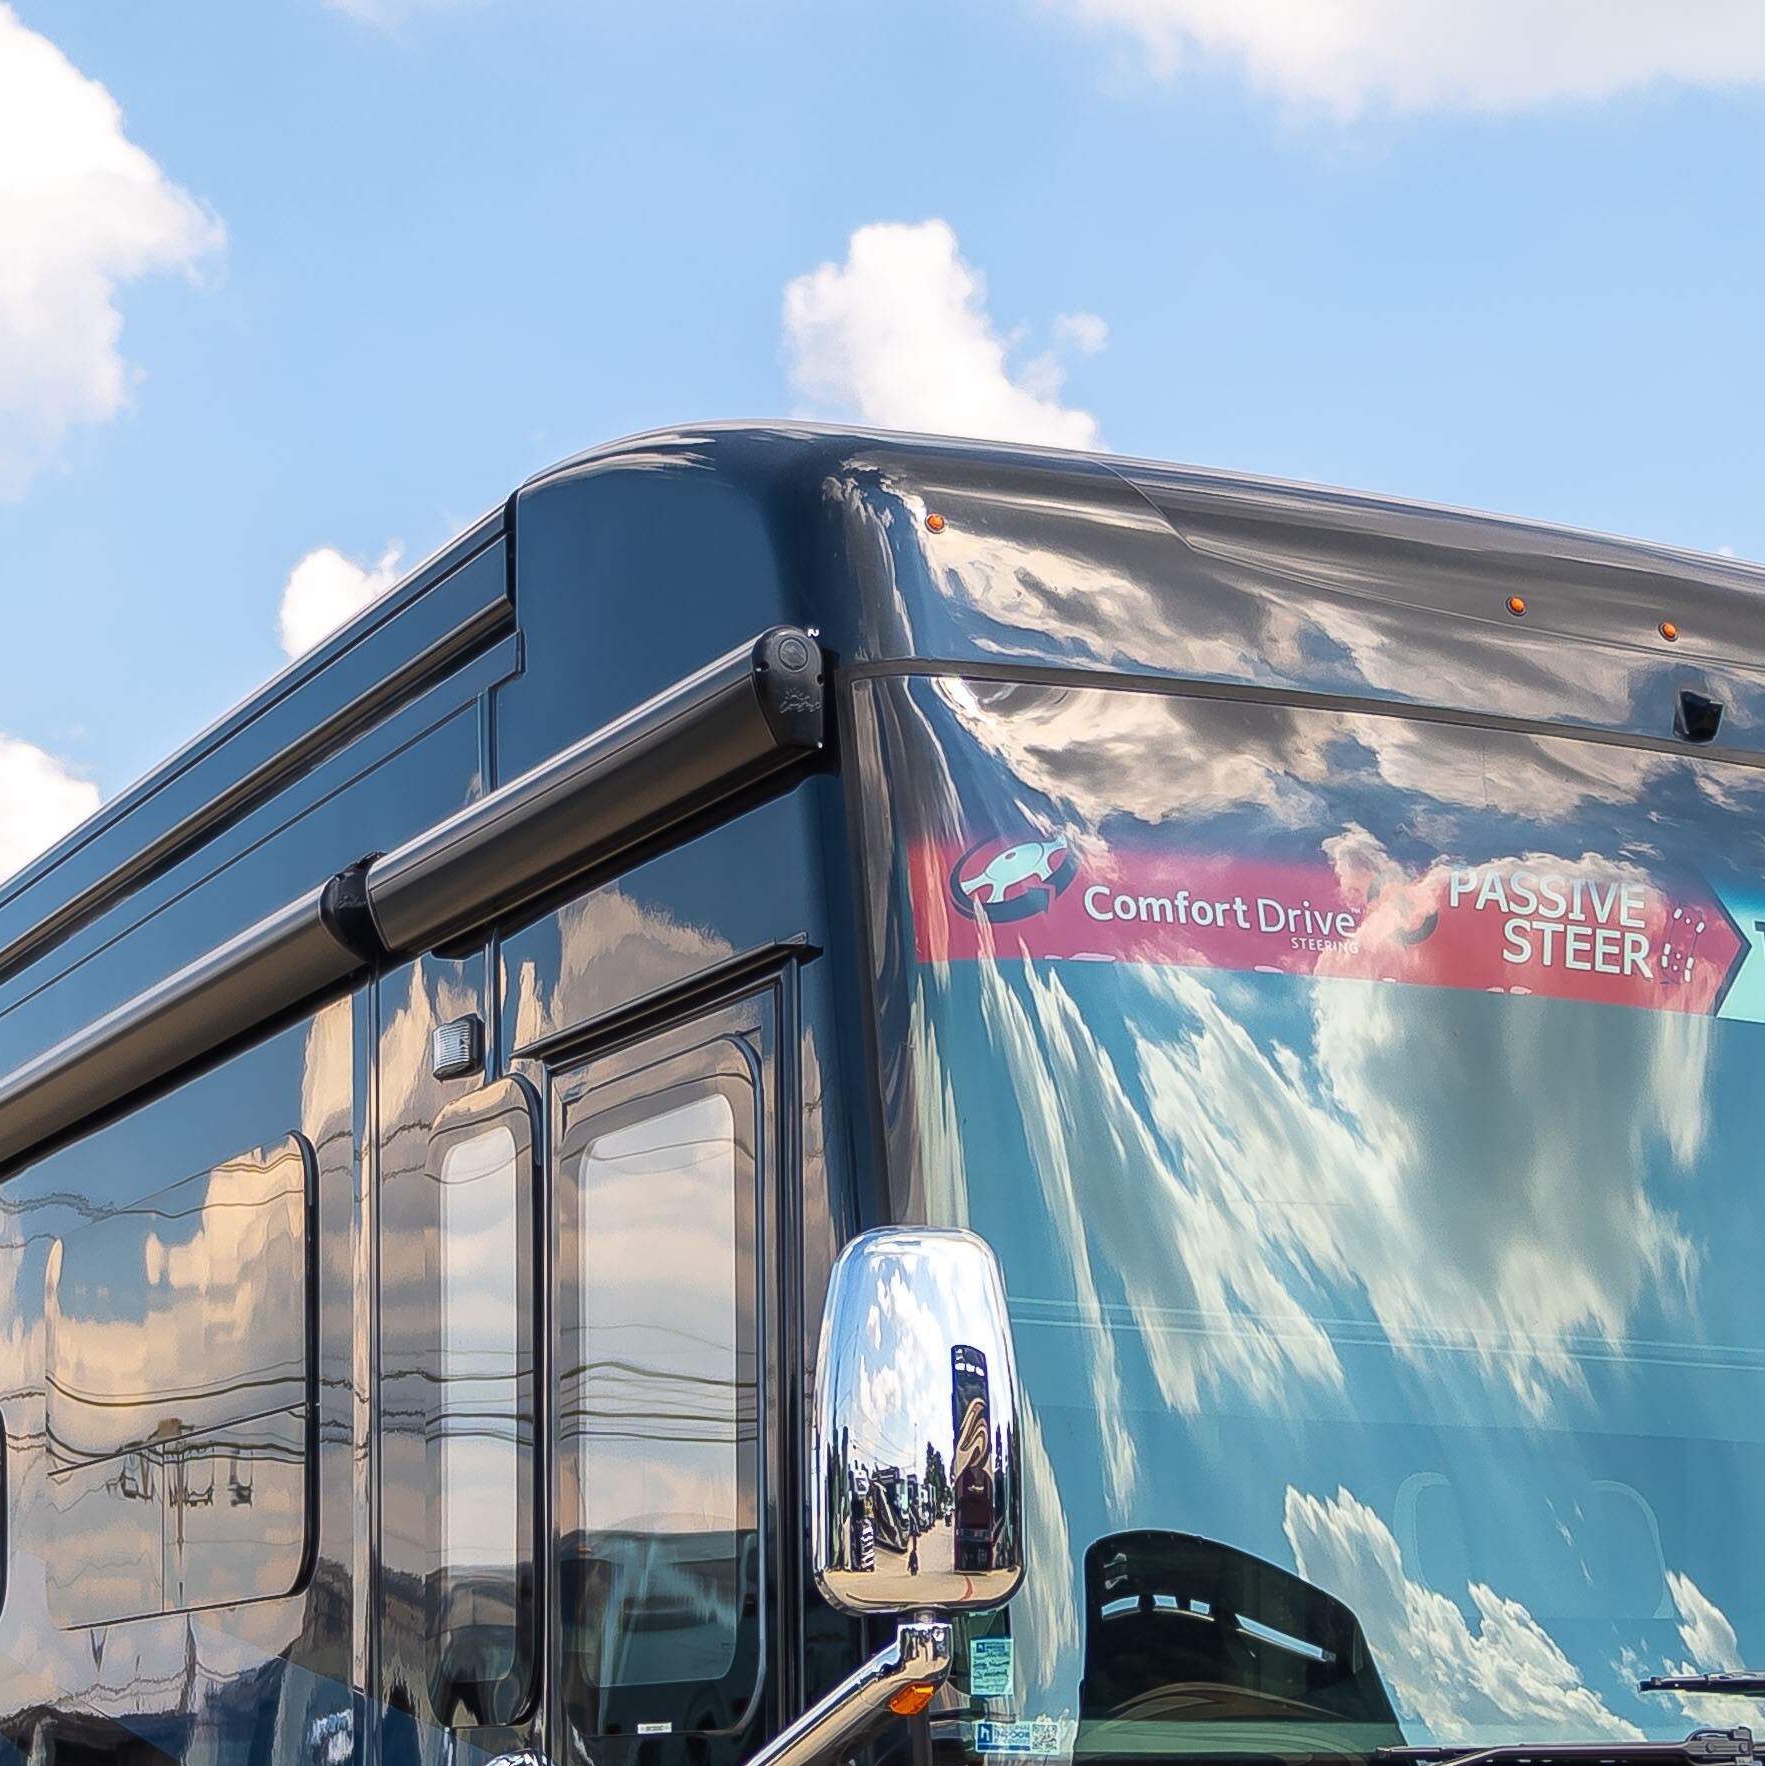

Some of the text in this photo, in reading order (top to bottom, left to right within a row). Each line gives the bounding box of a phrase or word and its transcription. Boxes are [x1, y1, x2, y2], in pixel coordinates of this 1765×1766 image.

[1084, 885, 1251, 929] Comfort
[1448, 867, 1647, 929] PASSIVE
[1290, 936, 1360, 955] STEERING
[1502, 917, 1654, 979] STEER
